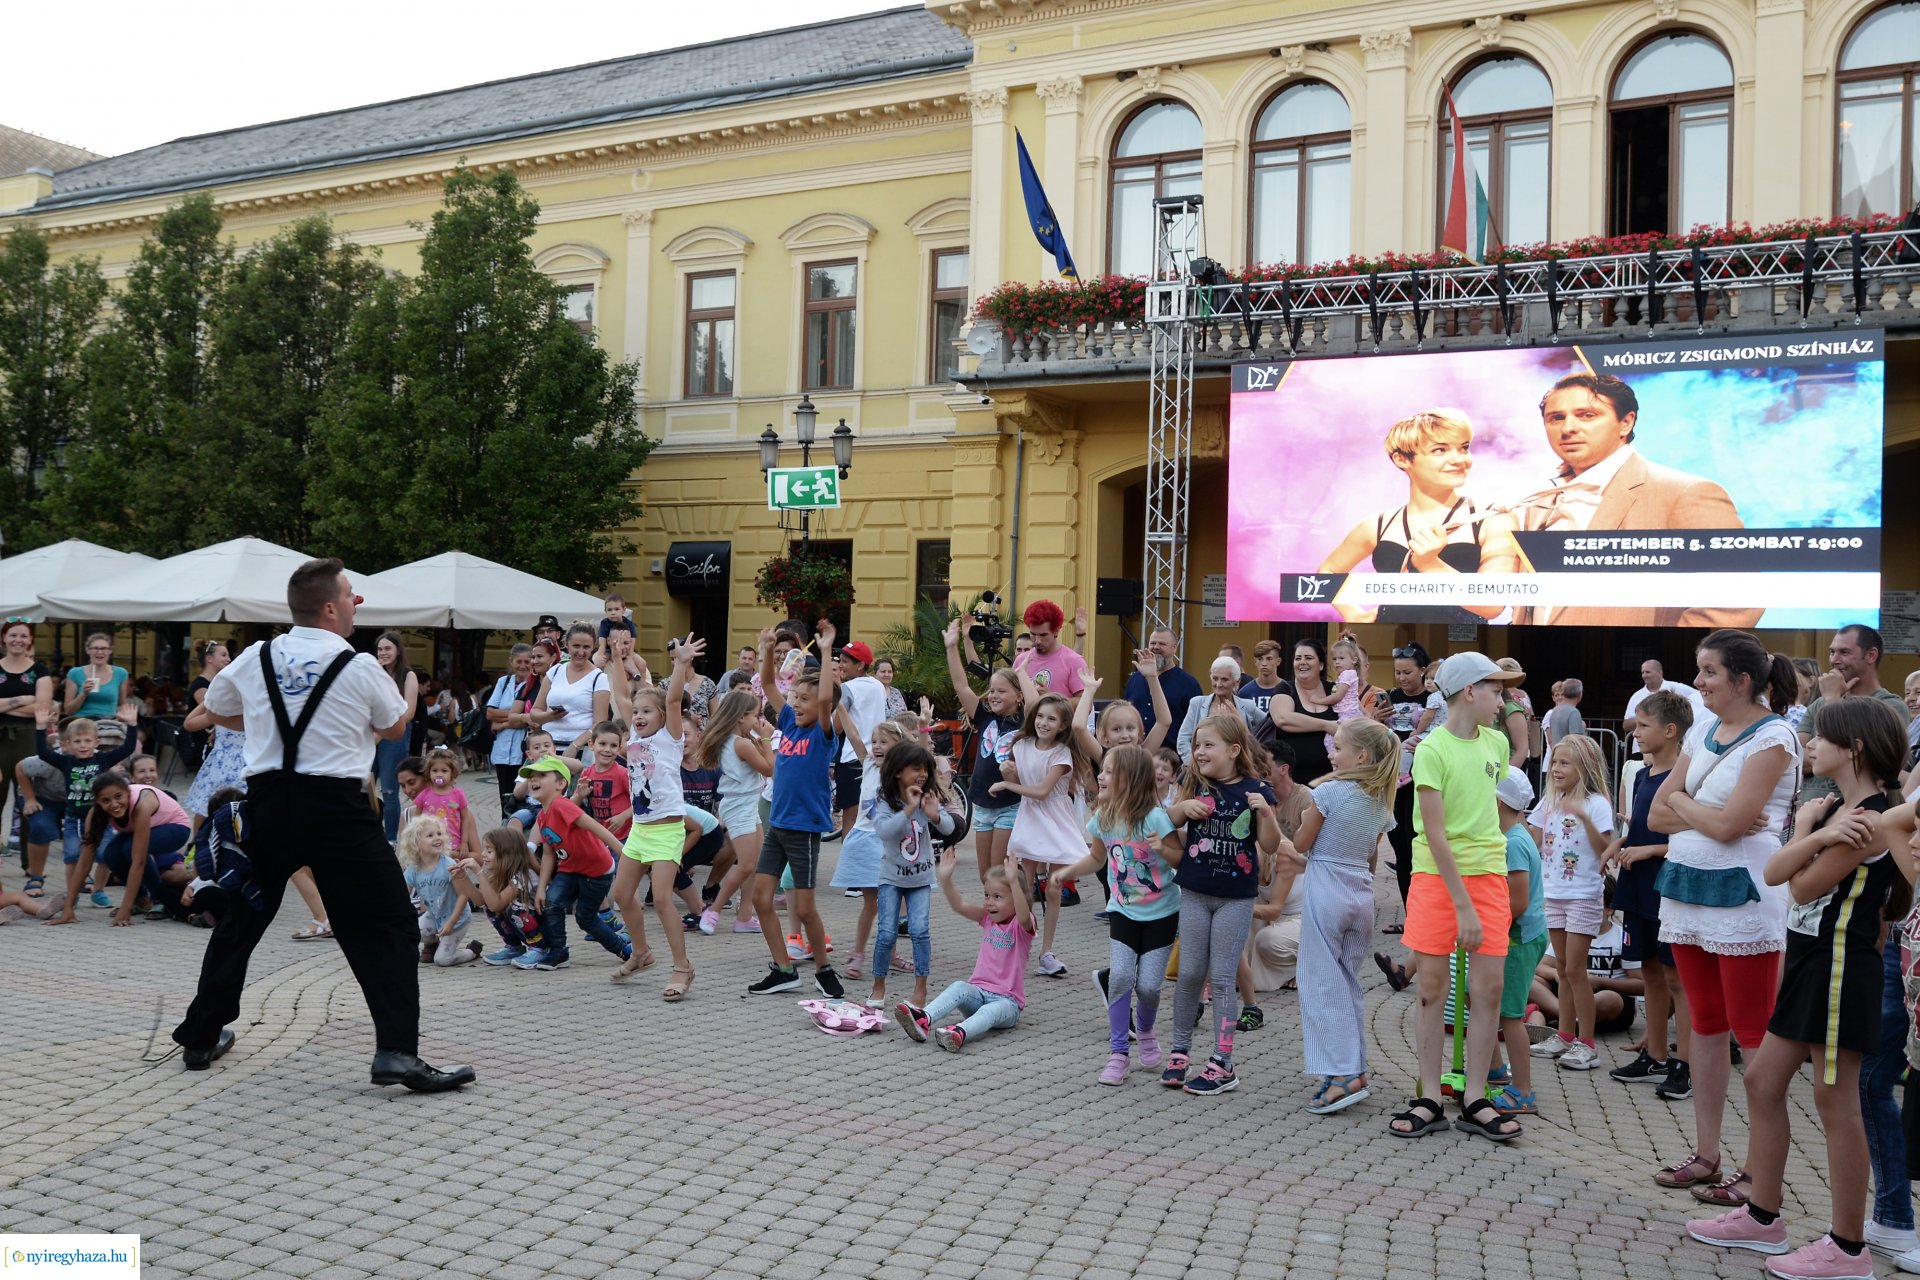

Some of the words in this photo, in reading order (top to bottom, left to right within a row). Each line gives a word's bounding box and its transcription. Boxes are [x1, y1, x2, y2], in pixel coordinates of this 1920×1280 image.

[1603, 351, 1676, 367] MÓRICZ
[1680, 346, 1783, 364] ZSIGMOND
[1786, 339, 1874, 357] SZÍNHÁZ
[1563, 537, 1685, 551] SZEPTEMBER
[1689, 540, 1705, 551] 5.
[1710, 536, 1804, 550] SZOMBAT
[1808, 537, 1863, 550] 19:00
[1563, 554, 1671, 566] NAGYSZÍNPAD
[1365, 583, 1396, 594] EDES
[1400, 583, 1455, 594] CHARITY
[1468, 583, 1540, 595] BEMUTATO
[1209, 838, 1240, 856] RETTY
